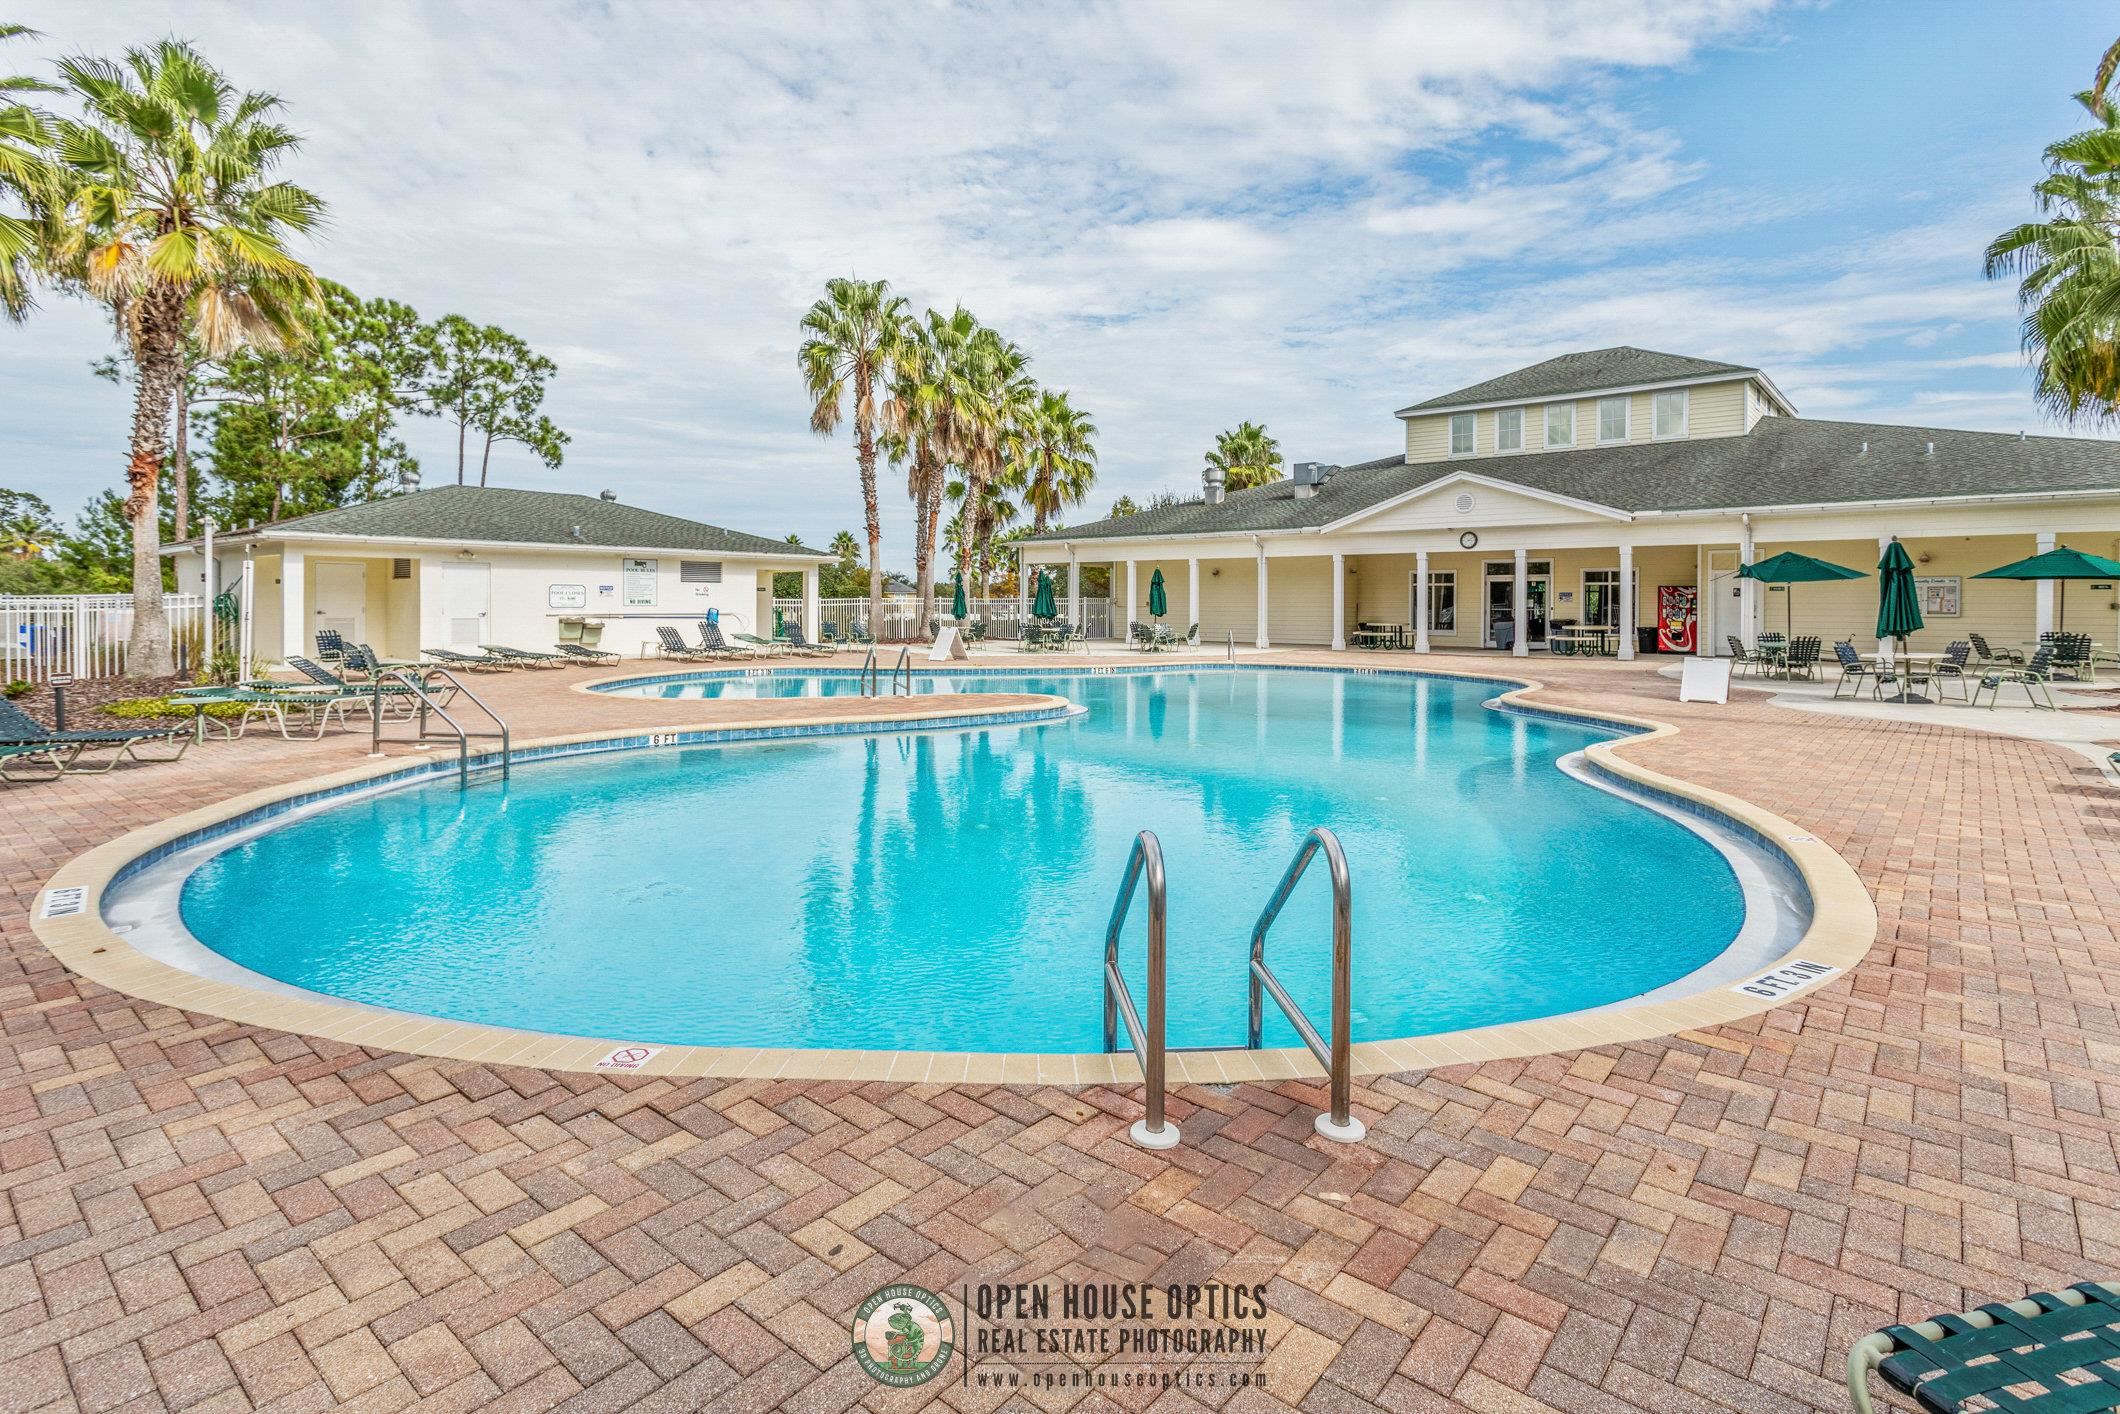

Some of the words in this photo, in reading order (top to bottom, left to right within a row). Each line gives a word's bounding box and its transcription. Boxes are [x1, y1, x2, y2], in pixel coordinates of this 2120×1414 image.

[653, 735, 659, 744] 6
[664, 734, 676, 743] FT
[1743, 986, 1777, 997] 6
[1780, 969, 1812, 980] 3
